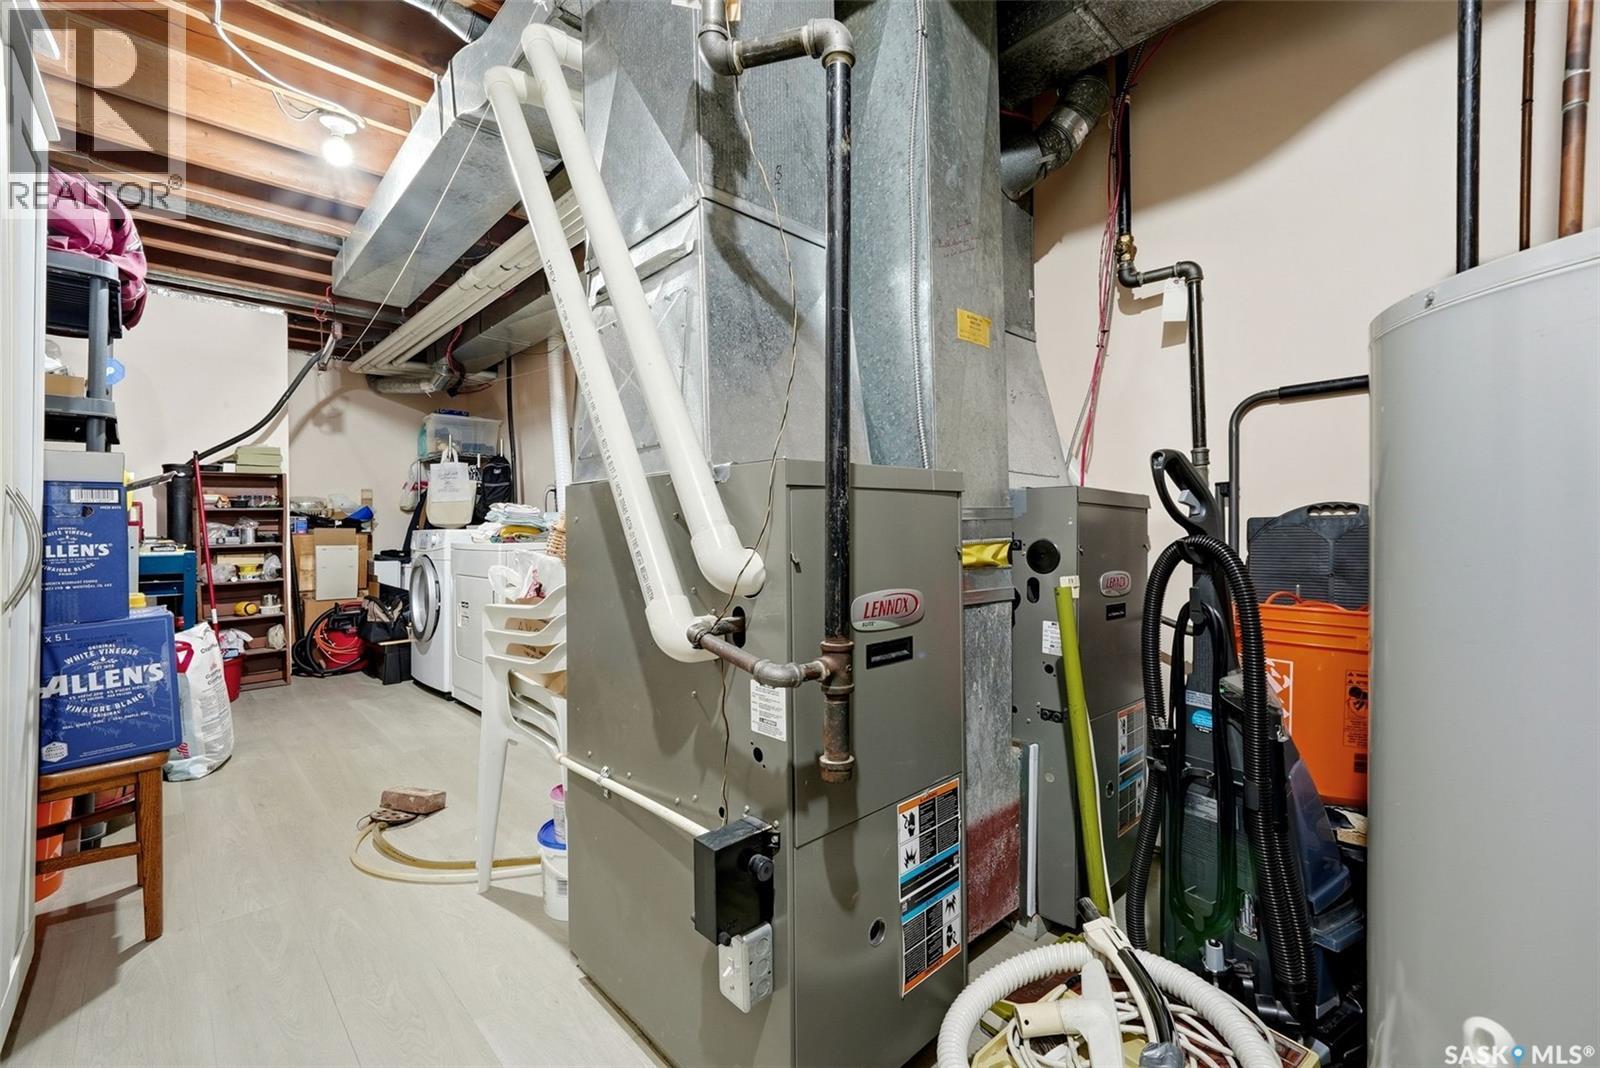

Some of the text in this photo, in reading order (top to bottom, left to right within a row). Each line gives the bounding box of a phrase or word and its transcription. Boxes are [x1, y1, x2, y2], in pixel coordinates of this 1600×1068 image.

[863, 597, 909, 619] LENNOX
[64, 647, 139, 665] WHITE VINEGAR
[39, 662, 164, 699] ALLEN'S
[65, 703, 112, 714] VINAIGRE
[114, 692, 145, 710] BLANC
